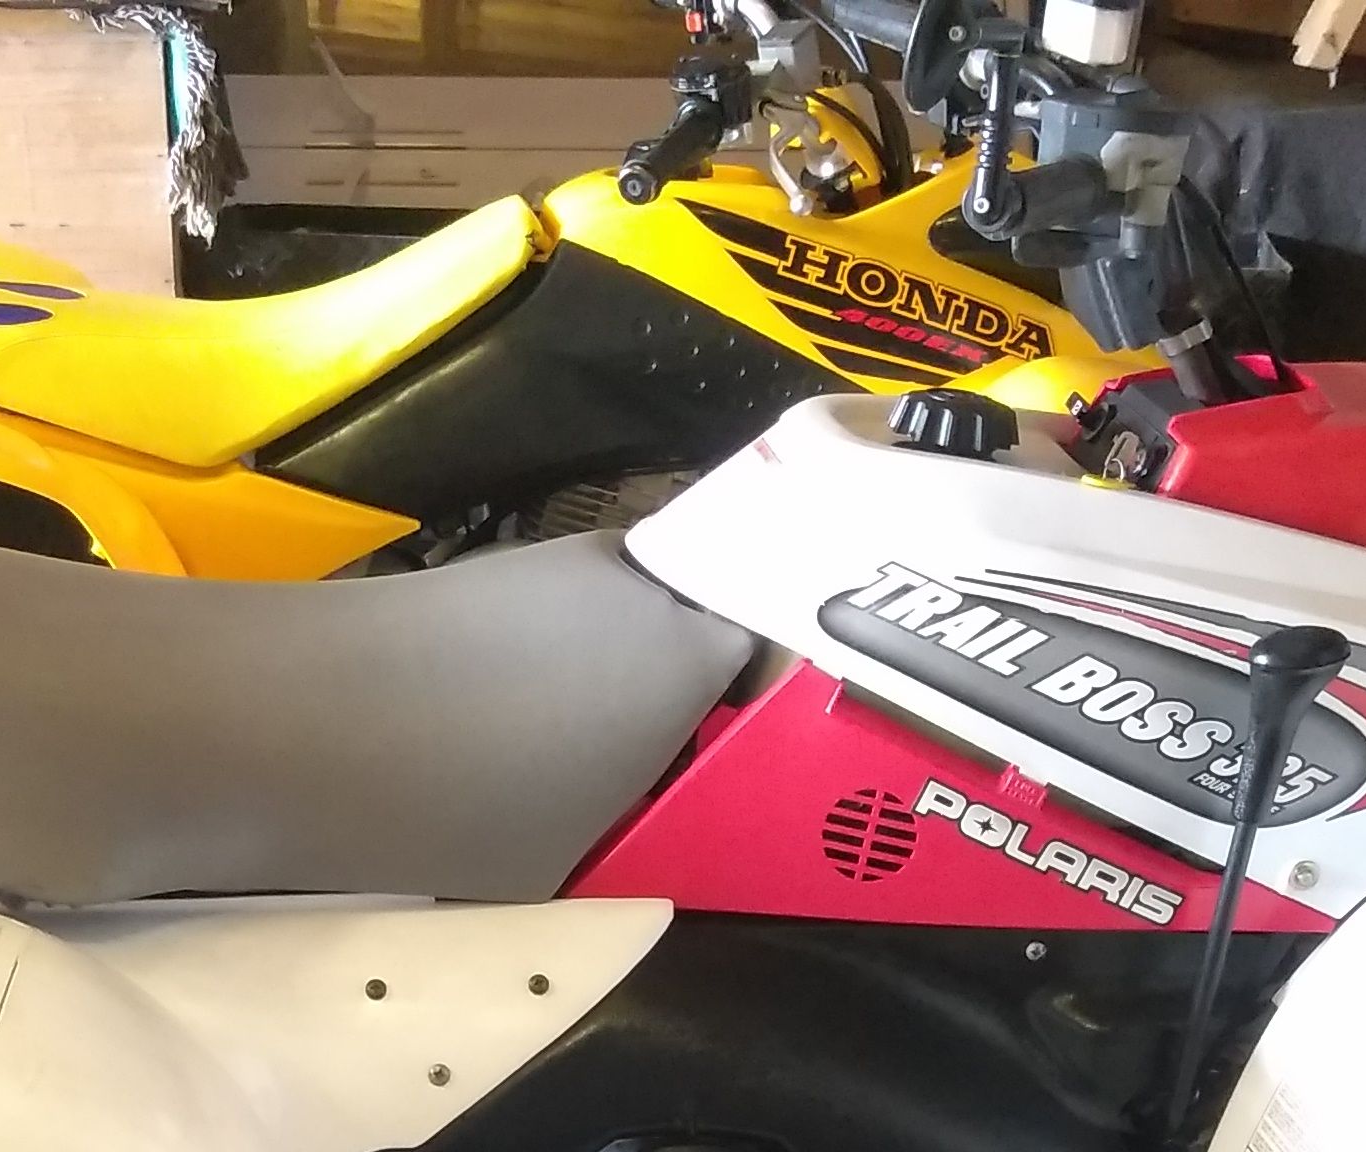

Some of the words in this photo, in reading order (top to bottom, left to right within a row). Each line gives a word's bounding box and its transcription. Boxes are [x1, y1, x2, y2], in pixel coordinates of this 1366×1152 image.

[778, 236, 1055, 361] HONDA
[836, 307, 989, 363] 400EX
[847, 562, 1053, 677] TRAIL
[1031, 654, 1235, 762] BOSS
[1192, 772, 1232, 796] FOUR
[914, 776, 1184, 926] POLARIS
